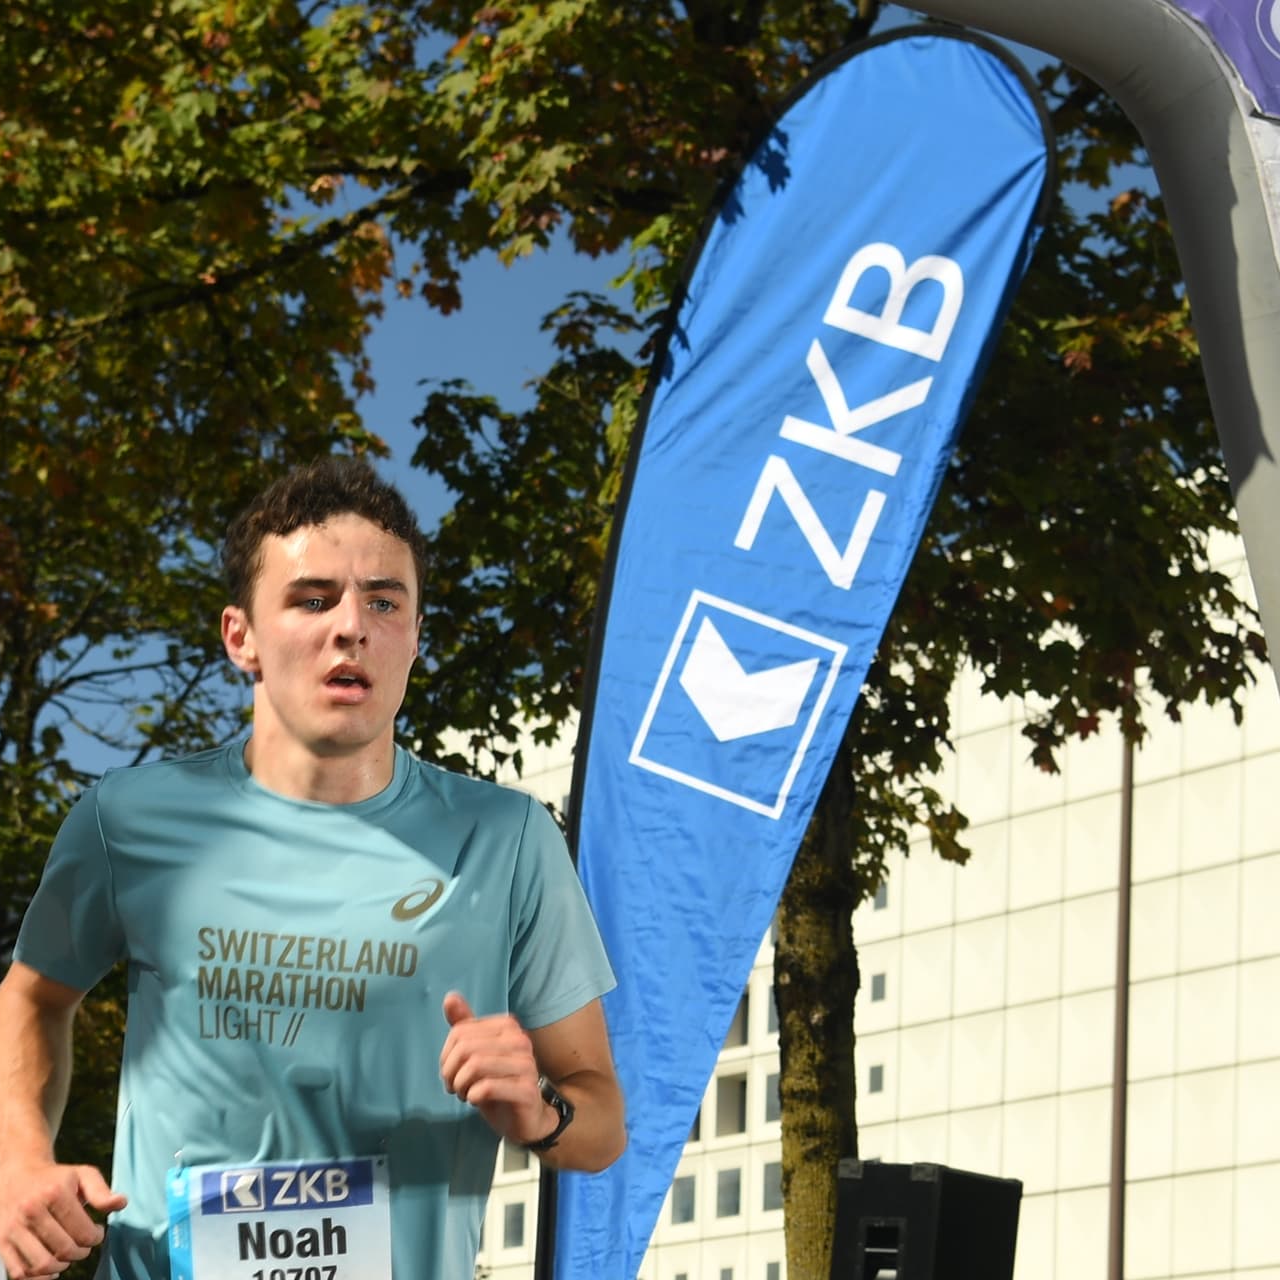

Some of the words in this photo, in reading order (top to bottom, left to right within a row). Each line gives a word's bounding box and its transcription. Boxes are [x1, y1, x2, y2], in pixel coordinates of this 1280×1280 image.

[733, 242, 964, 591] ZKB
[198, 927, 418, 978] SWITZERLAND
[197, 965, 367, 1013] MARATHON
[198, 1004, 281, 1044] LIGHT
[272, 1168, 350, 1206] ZKB
[237, 1217, 347, 1261] Noah
